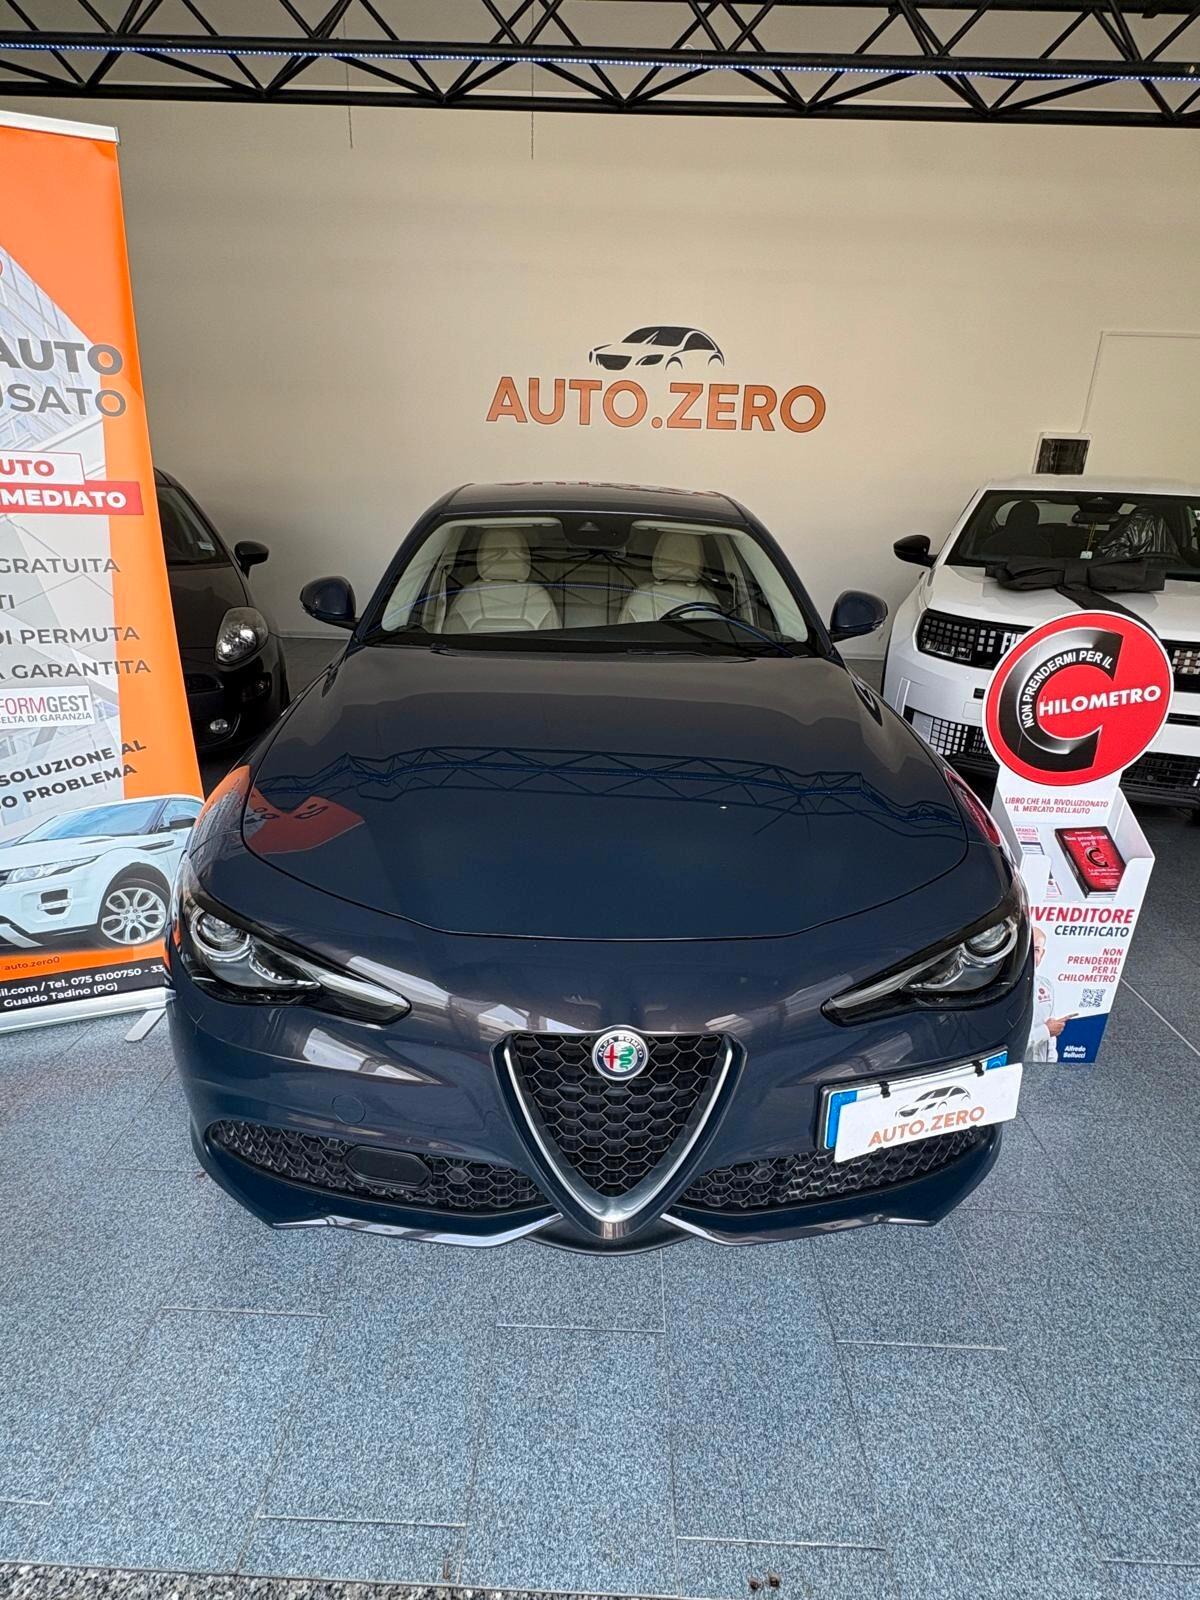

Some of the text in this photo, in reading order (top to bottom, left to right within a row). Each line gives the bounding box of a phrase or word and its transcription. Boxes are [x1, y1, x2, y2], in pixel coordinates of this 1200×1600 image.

[0, 383, 127, 417] SATO
[485, 376, 826, 433] AUTO.ZERO
[0, 558, 121, 574] GRATUITA
[20, 626, 140, 645] PERMUTA
[11, 659, 151, 679] GARANTITA
[1021, 650, 1113, 728] NON PRENDERMI PER IL
[27, 714, 38, 723] DI
[40, 712, 92, 722] GARANZIA
[0, 740, 147, 787] SOLUZIONE AL
[22, 764, 137, 803] PROBLEMA
[1005, 797, 1109, 808] LIBRO CHE HA RIVOLUZIONATO
[1022, 805, 1054, 813] MERCATO
[1055, 806, 1091, 815] DELL'AUTO
[1055, 925, 1129, 937] CERTIFICATO
[1067, 956, 1121, 965] PRENDERMI
[1102, 948, 1123, 957] NON
[1058, 973, 1116, 983] CHILOMETRO
[1091, 965, 1118, 975] PER IL
[0, 985, 38, 997] il.com
[47, 978, 69, 989] Tel.
[71, 974, 93, 986] 075
[95, 967, 141, 982] 6100750
[4, 982, 118, 1007] Gualdo Tadino (PG)
[868, 1106, 985, 1147] AUTO.ZERO
